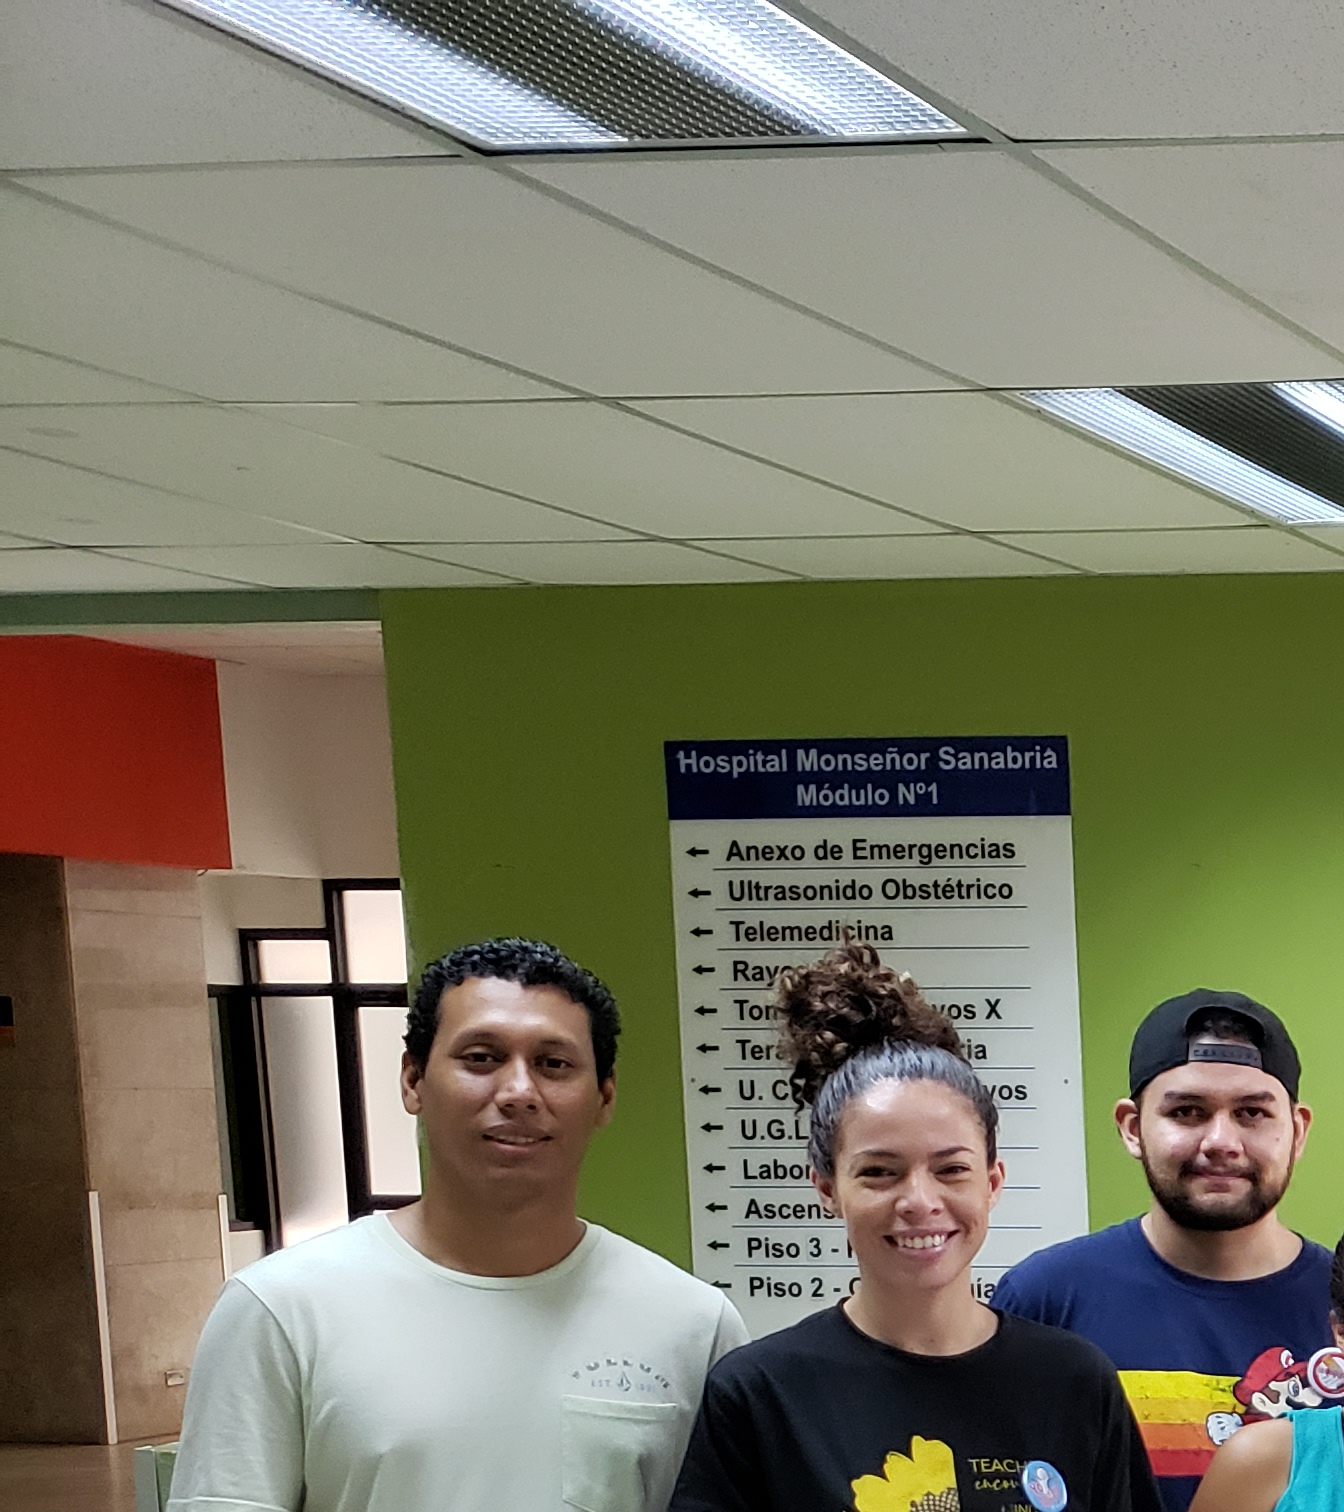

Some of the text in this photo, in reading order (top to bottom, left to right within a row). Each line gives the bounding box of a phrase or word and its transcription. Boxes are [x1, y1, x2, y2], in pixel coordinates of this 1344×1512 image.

[678, 746, 1058, 778] Hospital Monseñor Sanabria
[796, 783, 889, 806] Módulo
[725, 837, 1016, 866] Anexo de Emergencias
[728, 877, 1013, 902] Ultrasonido Obstétrico
[729, 920, 894, 942] Telemedicina
[985, 998, 1003, 1020] X
[739, 1080, 763, 1101] U.
[741, 1119, 809, 1141] U.G.L
[743, 1159, 811, 1180] Labor
[747, 1237, 800, 1259] Piso
[808, 1237, 823, 1258] 3
[749, 1277, 802, 1298] Piso
[810, 1277, 825, 1298] 2
